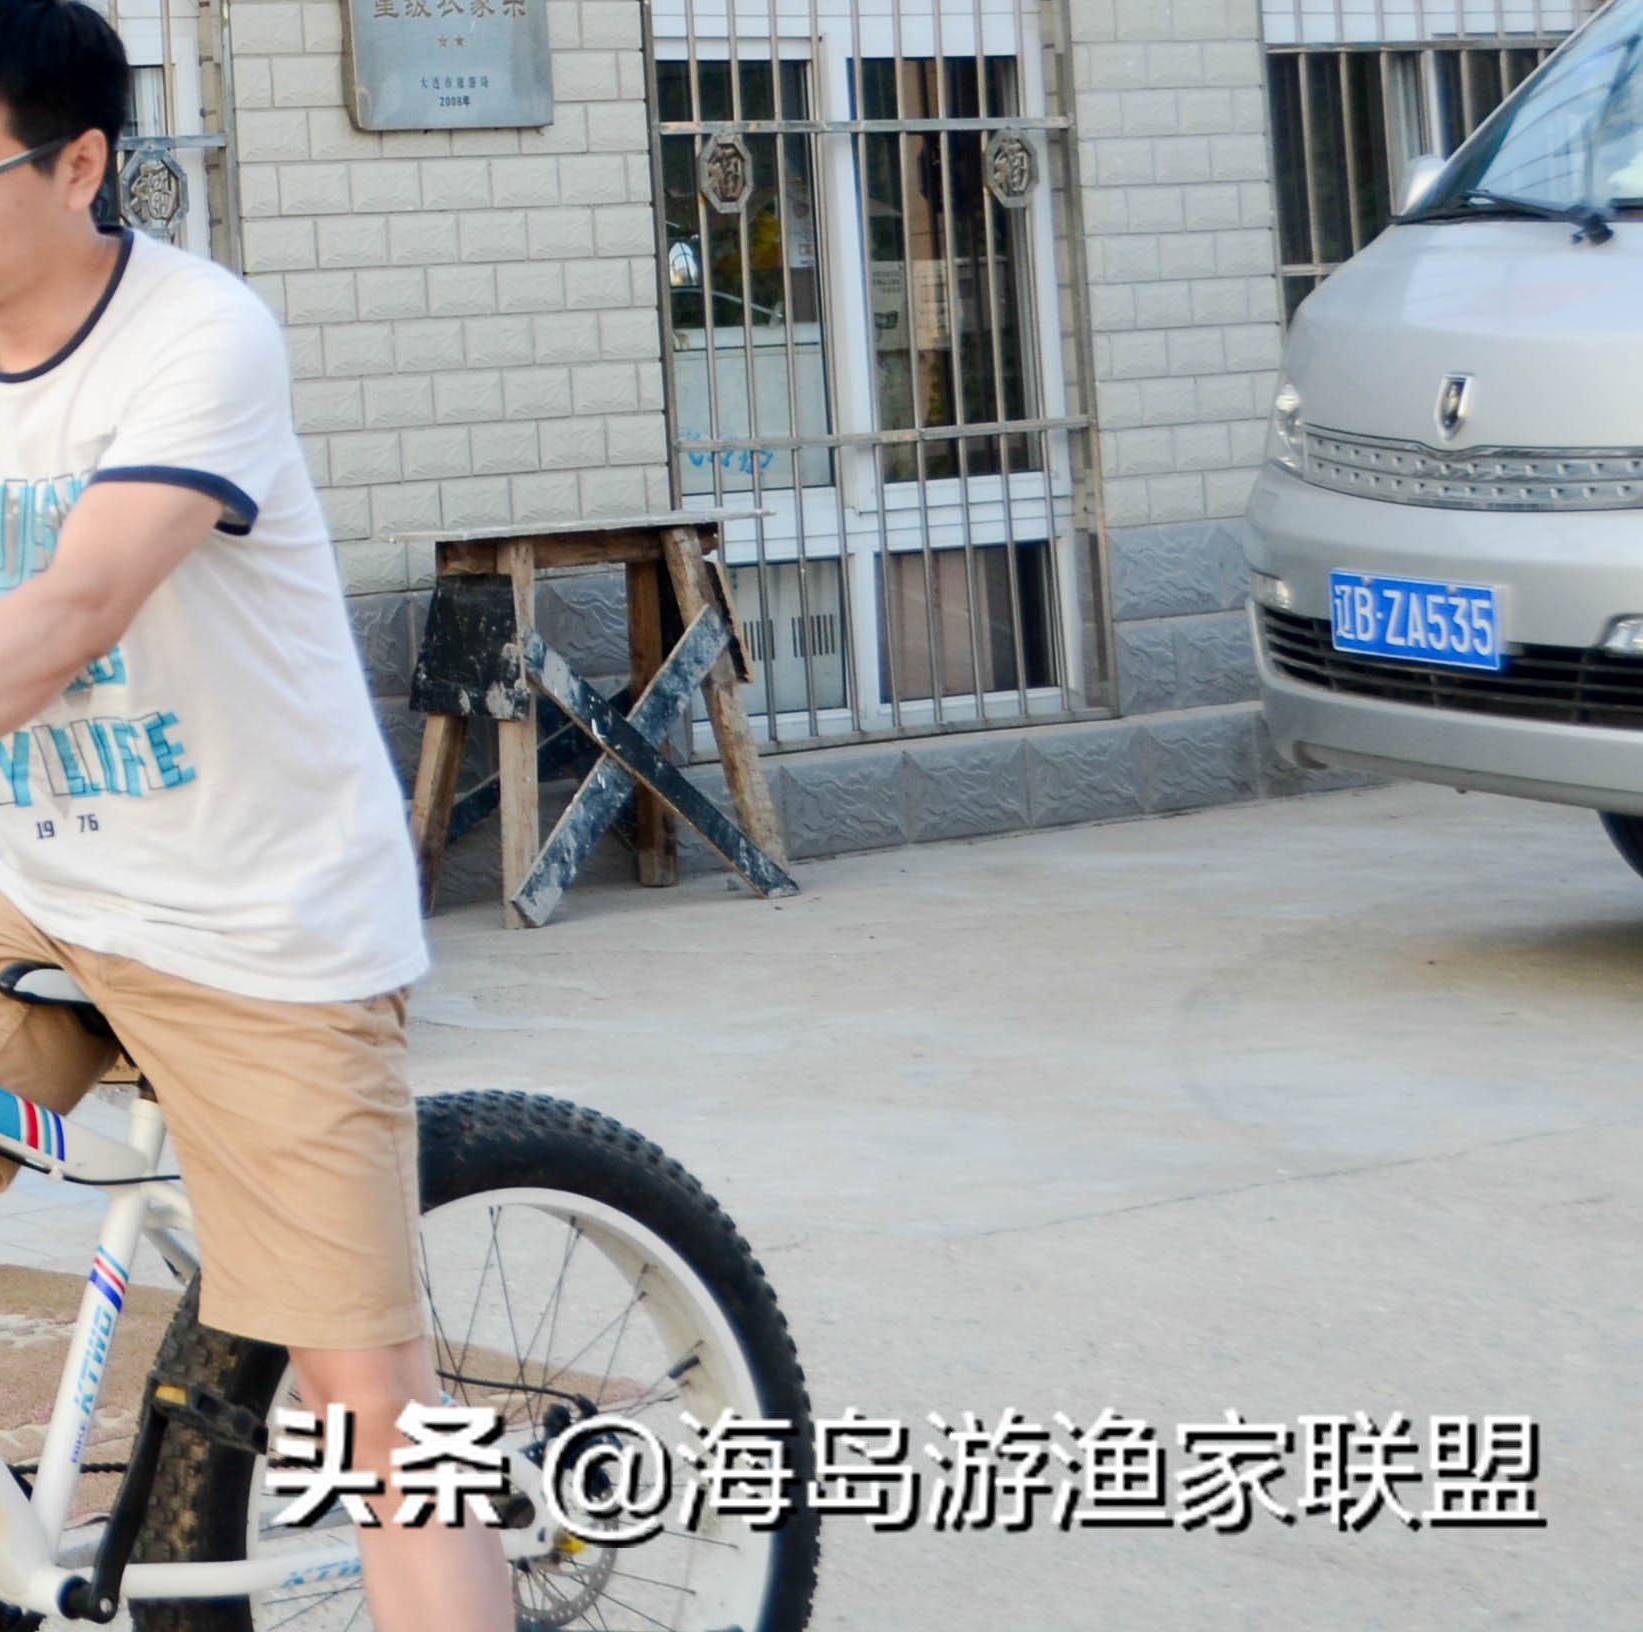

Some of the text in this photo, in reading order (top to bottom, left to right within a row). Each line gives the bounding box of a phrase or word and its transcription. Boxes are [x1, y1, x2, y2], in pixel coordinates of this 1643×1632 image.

[35, 814, 99, 840] 19 76
[75, 1304, 114, 1417] KTWO
